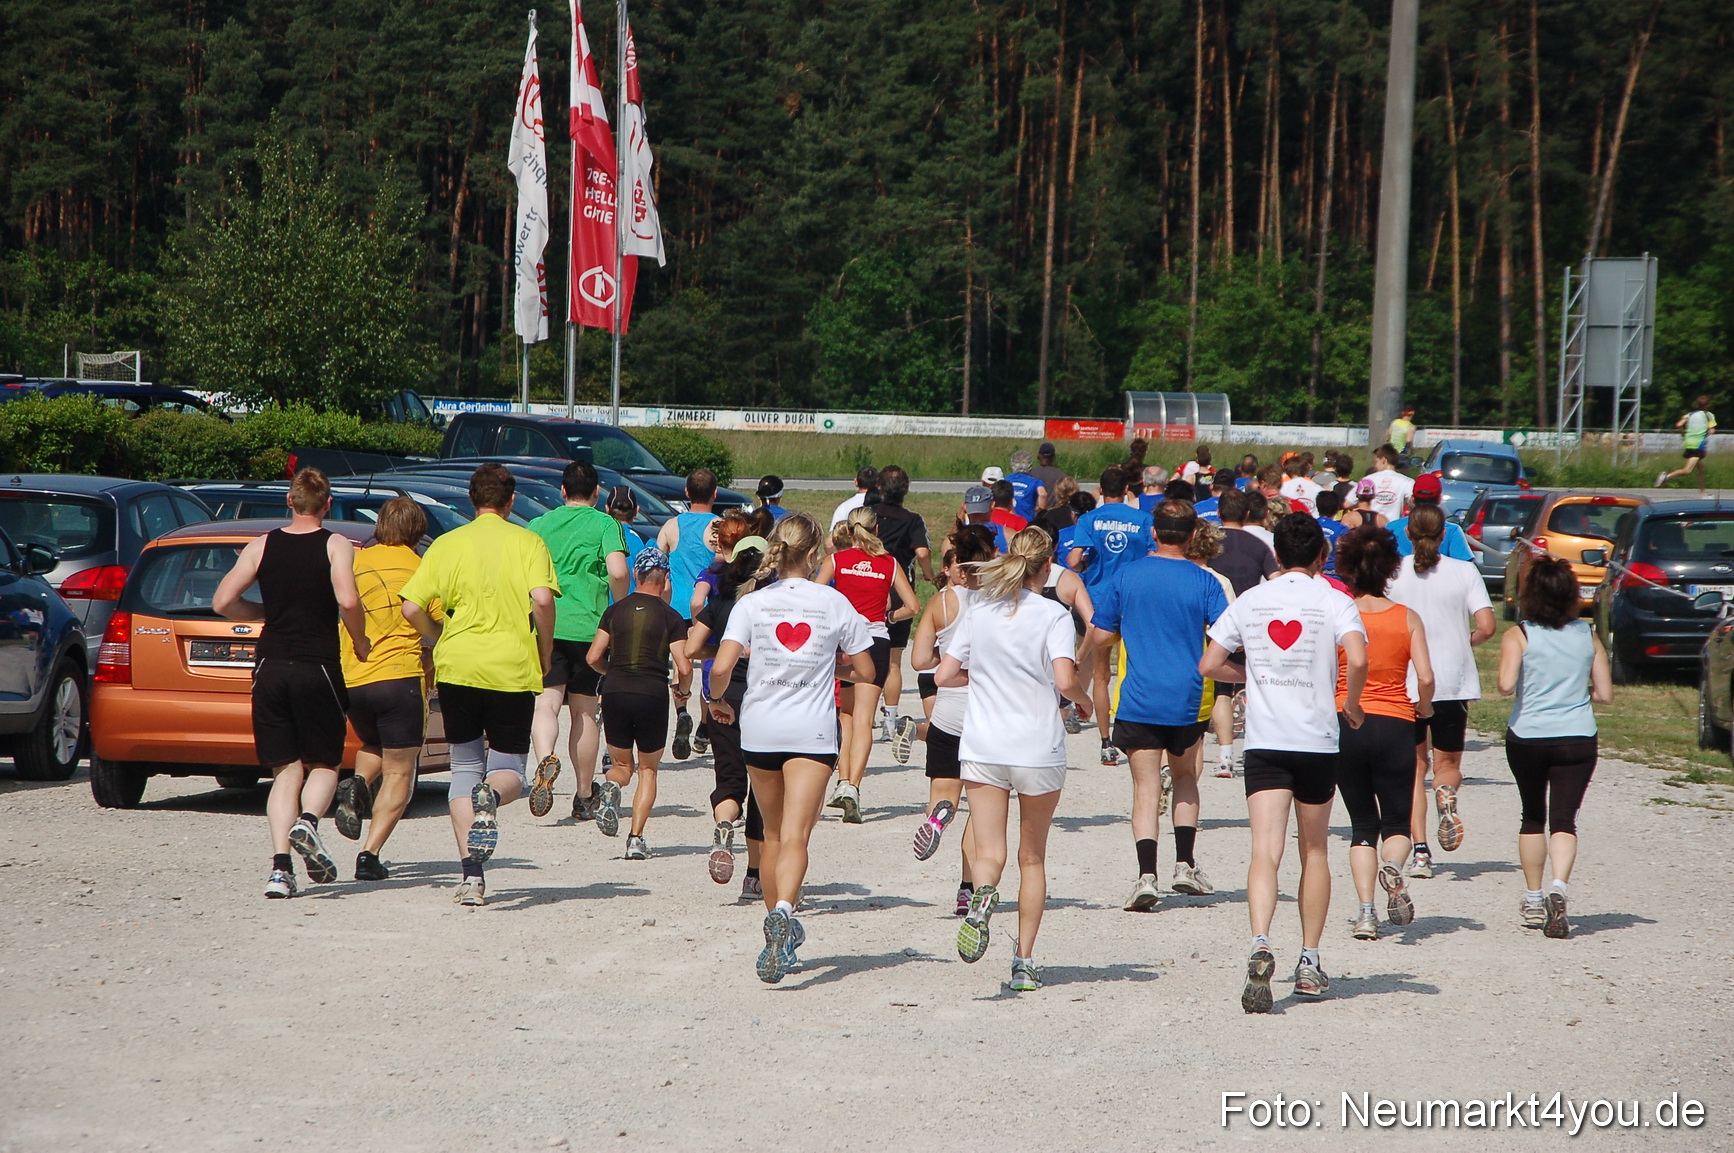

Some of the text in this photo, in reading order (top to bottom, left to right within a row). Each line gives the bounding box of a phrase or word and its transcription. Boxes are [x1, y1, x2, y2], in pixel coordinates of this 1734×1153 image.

[436, 401, 457, 410] Jura
[667, 410, 716, 422] ZIMMEREI
[744, 412, 780, 423] OLIVER
[1093, 520, 1140, 533] Waldläufer
